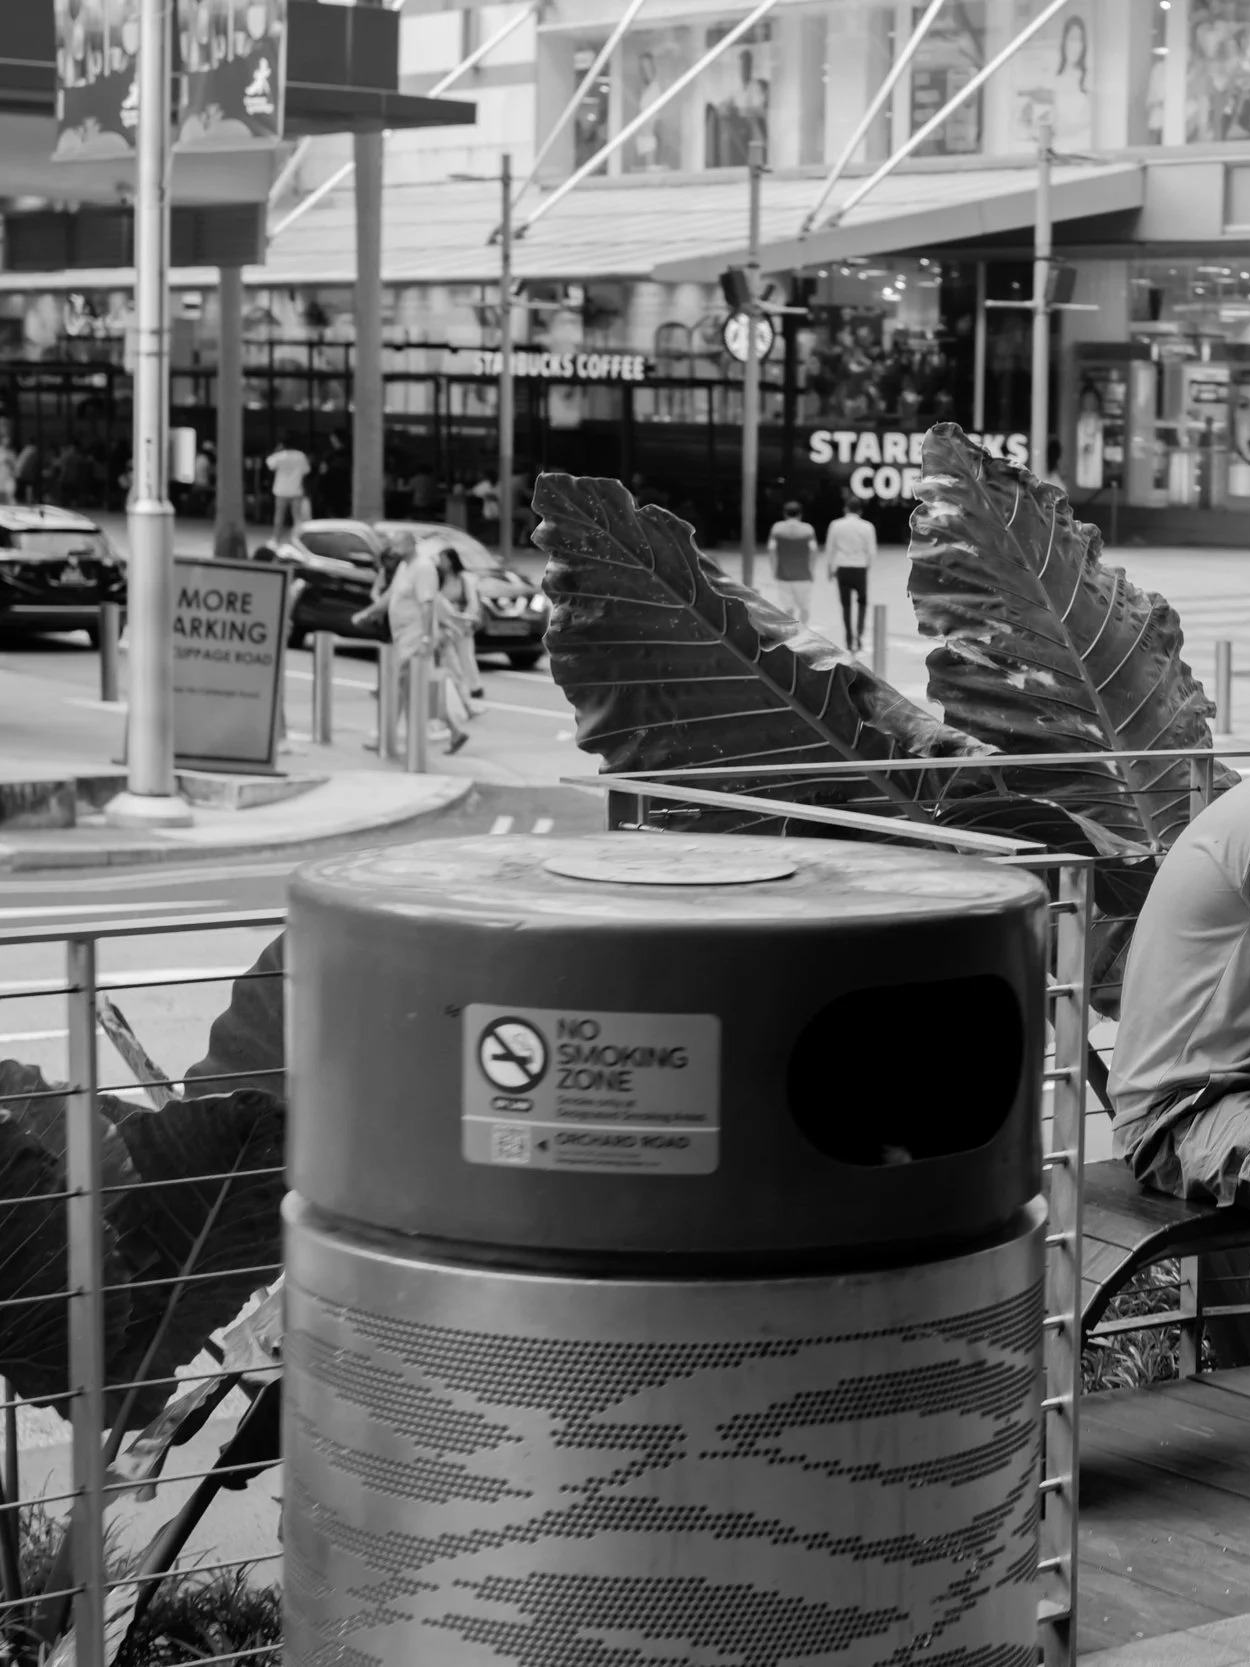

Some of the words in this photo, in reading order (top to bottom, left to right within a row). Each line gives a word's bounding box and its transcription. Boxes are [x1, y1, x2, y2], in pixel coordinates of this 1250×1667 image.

[576, 354, 645, 380] COFFEE
[809, 430, 1029, 466] STARBKS
[850, 465, 922, 500] COF
[177, 587, 253, 615] MORE
[173, 616, 268, 645] ARKING
[173, 646, 231, 664] UPPAGE
[235, 652, 273, 667] ROAD
[556, 1018, 601, 1042] NO
[556, 1043, 689, 1069] SMOKING
[556, 1068, 634, 1092] ZONE
[554, 1131, 638, 1148] ORCHARD
[640, 1135, 691, 1149] ROAD
